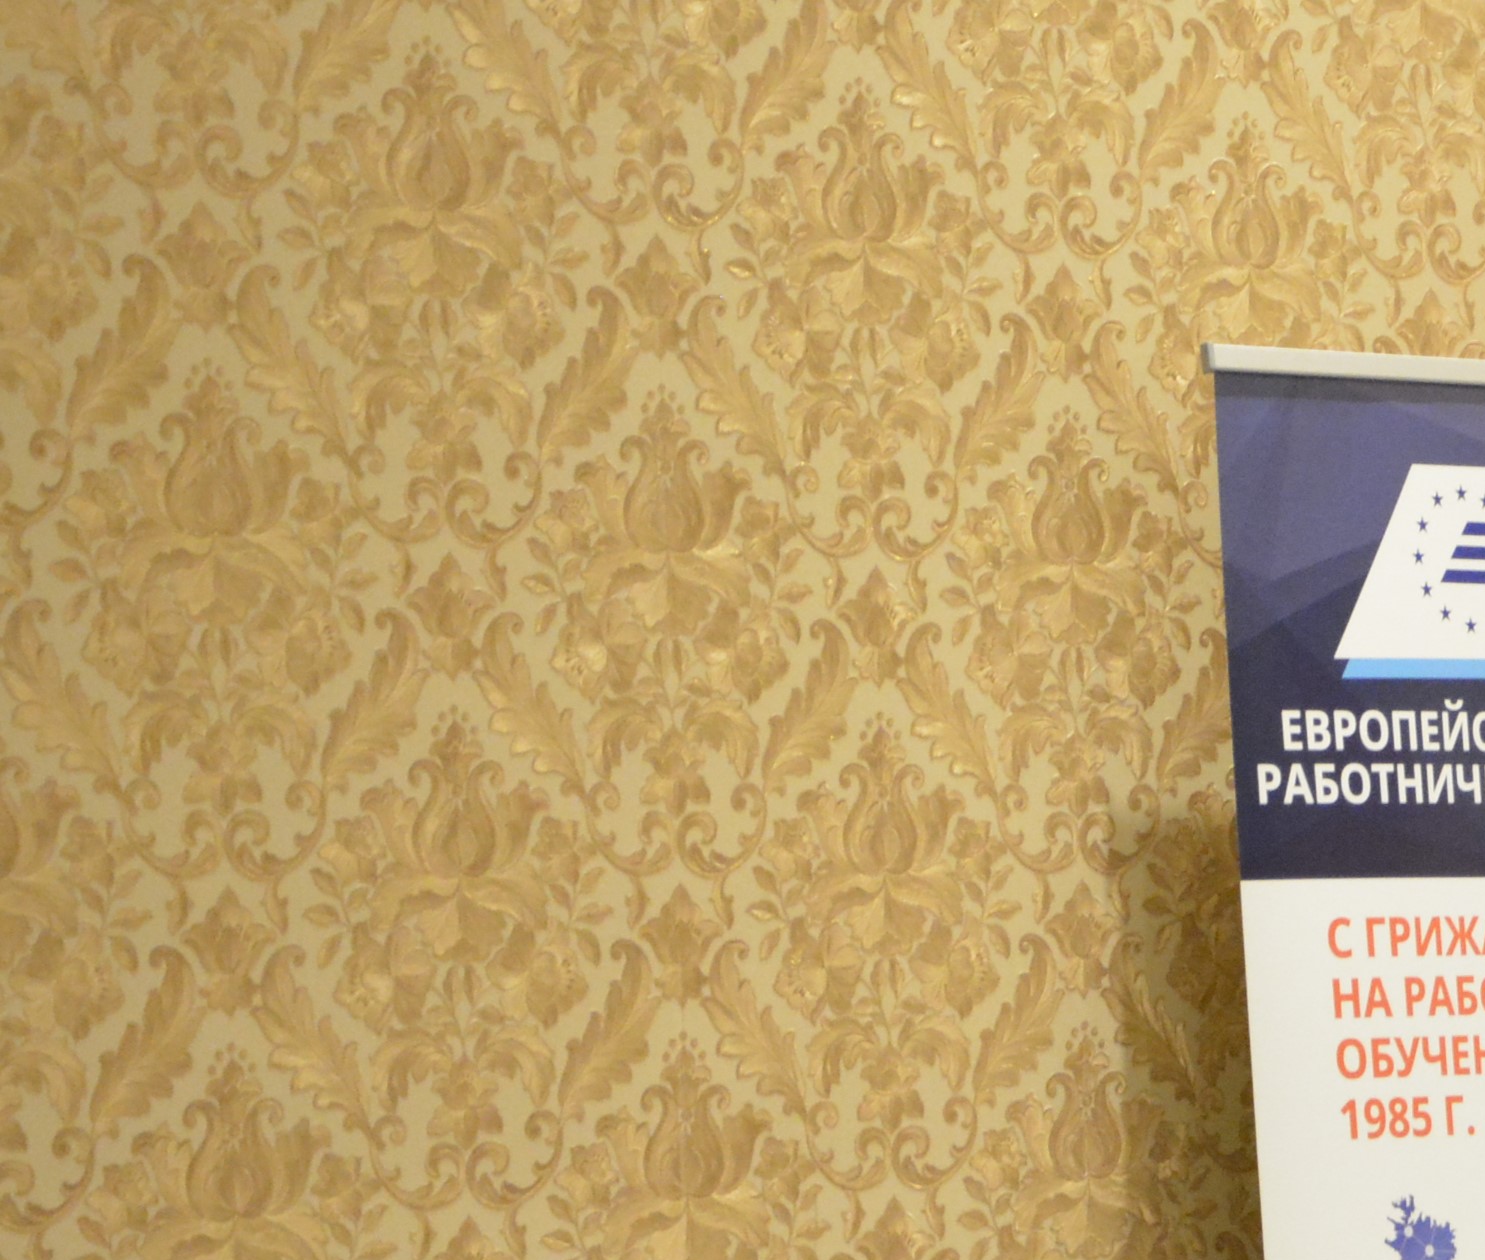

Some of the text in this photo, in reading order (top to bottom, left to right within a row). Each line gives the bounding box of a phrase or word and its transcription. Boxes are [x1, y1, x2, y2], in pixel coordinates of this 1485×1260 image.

[1328, 918, 1352, 958] С
[1333, 978, 1392, 1018] НА
[1342, 1095, 1475, 1139] 1985 Г.
